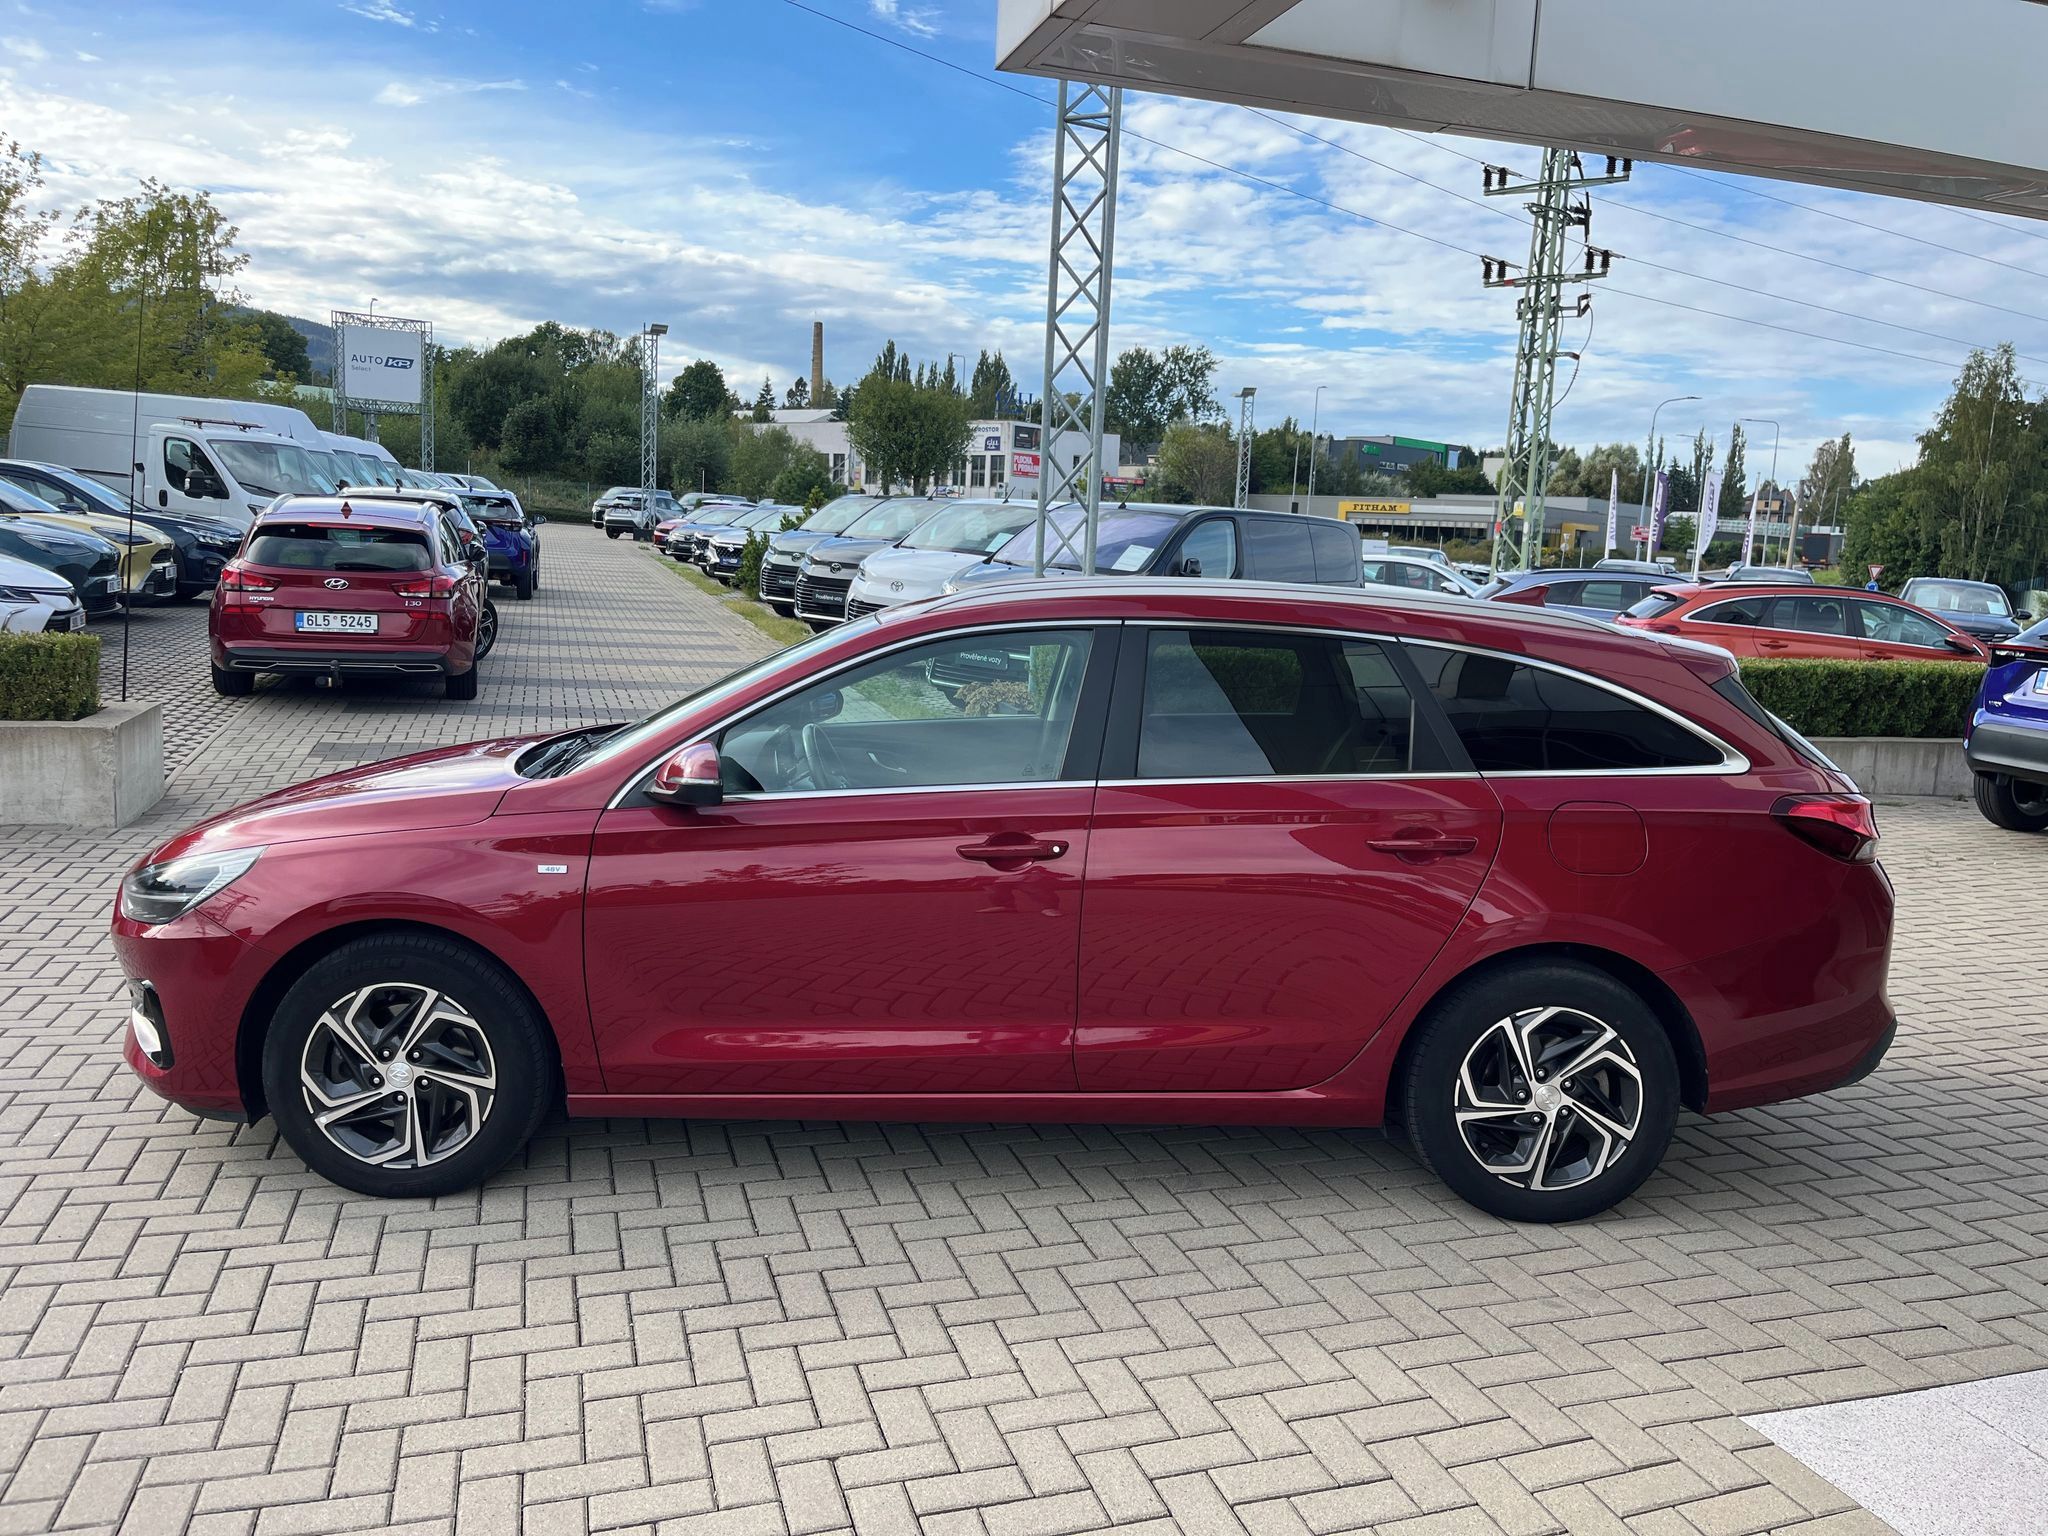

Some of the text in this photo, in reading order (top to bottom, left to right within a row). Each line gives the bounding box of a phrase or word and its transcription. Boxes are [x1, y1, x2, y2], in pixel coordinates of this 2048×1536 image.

[351, 354, 383, 365] AUTO
[351, 365, 371, 373] Select
[1353, 503, 1398, 512] FITHAM
[306, 614, 372, 628] 6L5 5245
